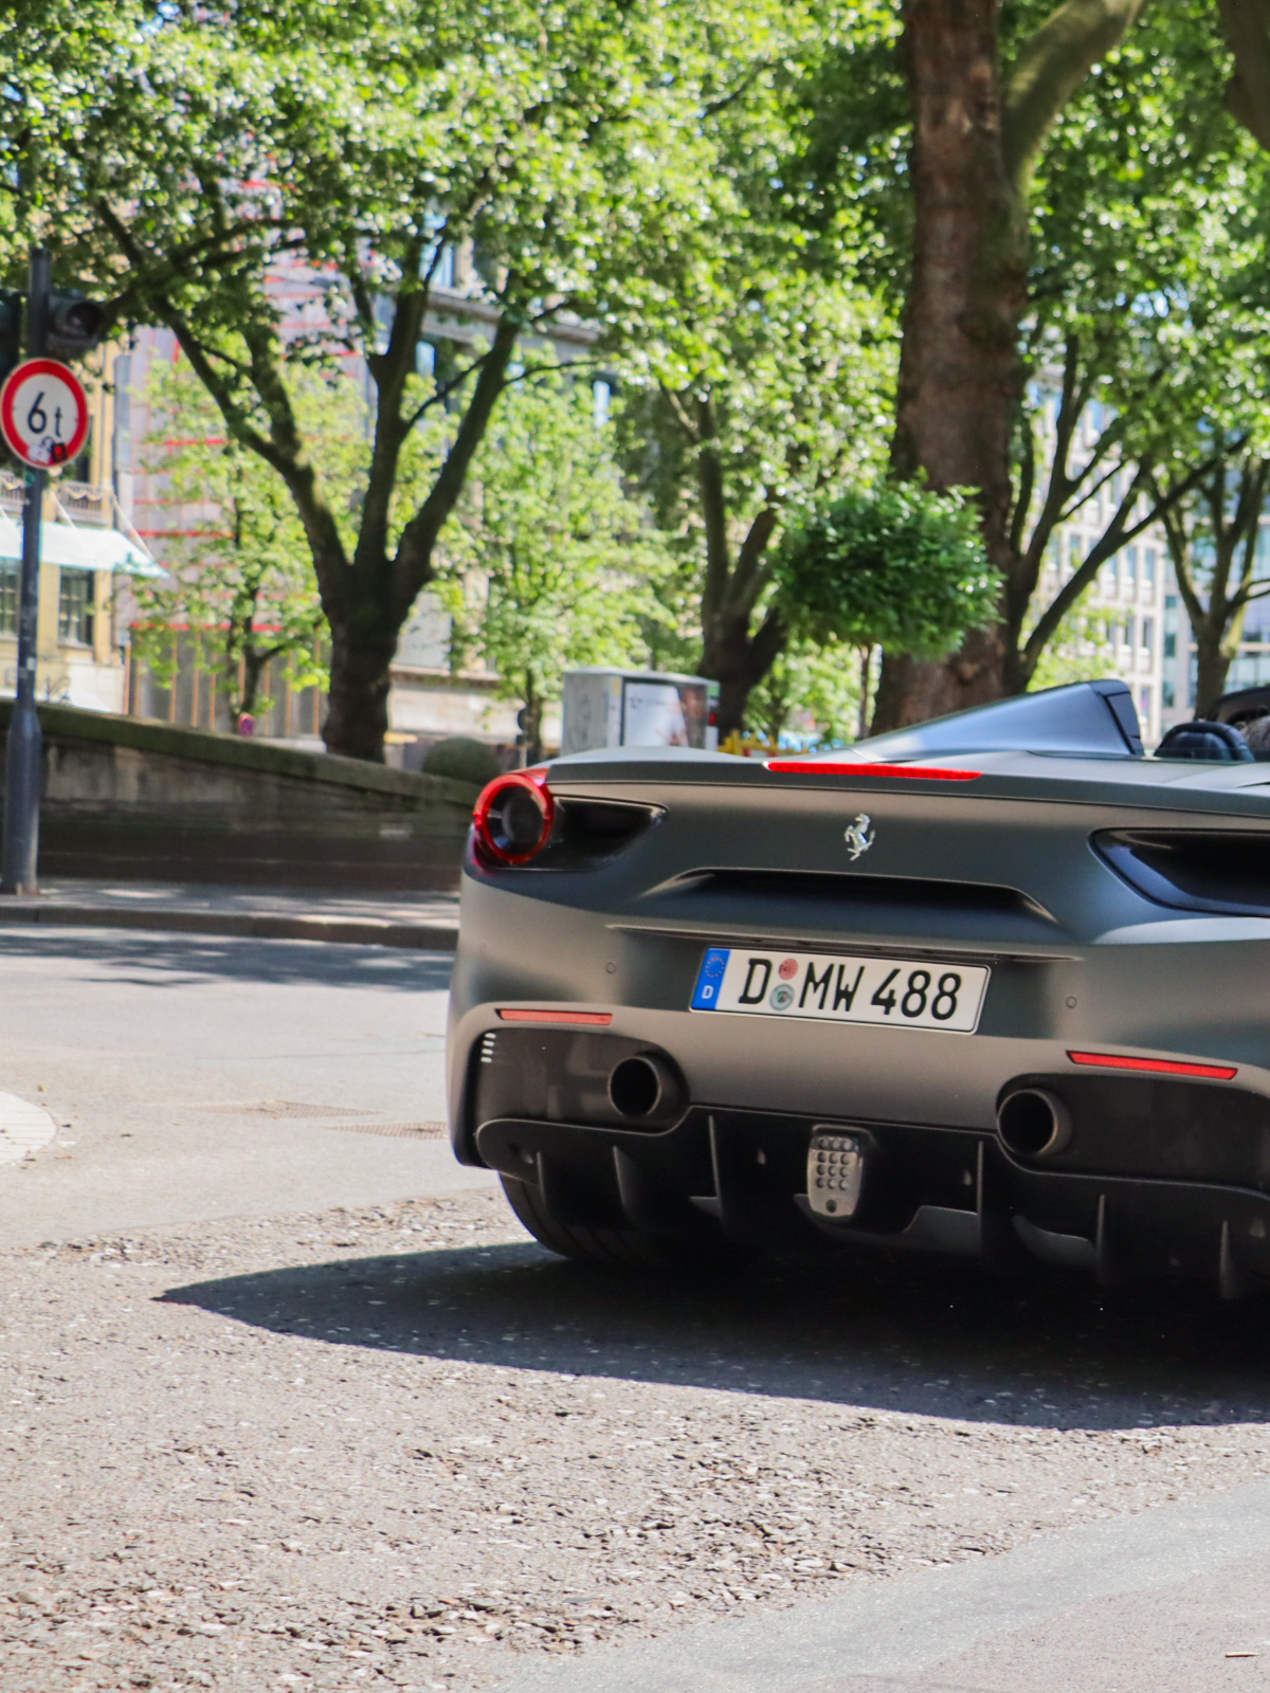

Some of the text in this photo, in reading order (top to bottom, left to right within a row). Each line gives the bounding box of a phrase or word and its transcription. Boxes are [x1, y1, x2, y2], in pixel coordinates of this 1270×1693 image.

[701, 985, 714, 999] D
[738, 958, 962, 1020] D MW 488
